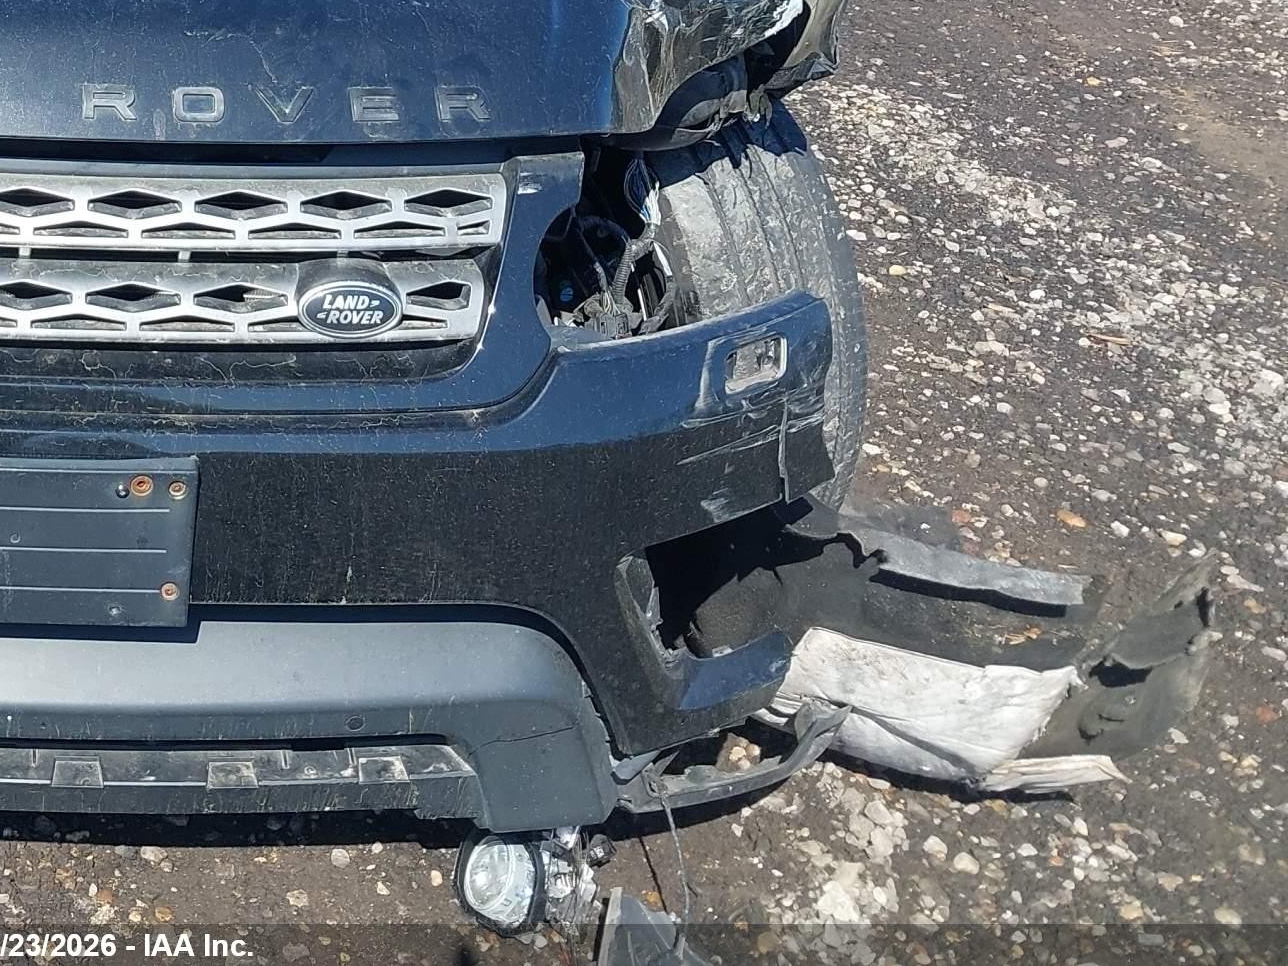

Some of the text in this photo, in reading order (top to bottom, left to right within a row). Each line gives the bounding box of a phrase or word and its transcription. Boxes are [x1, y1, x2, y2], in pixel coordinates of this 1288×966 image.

[81, 82, 493, 123] ROVER
[323, 294, 370, 310] LAND
[326, 310, 384, 324] ROVER
